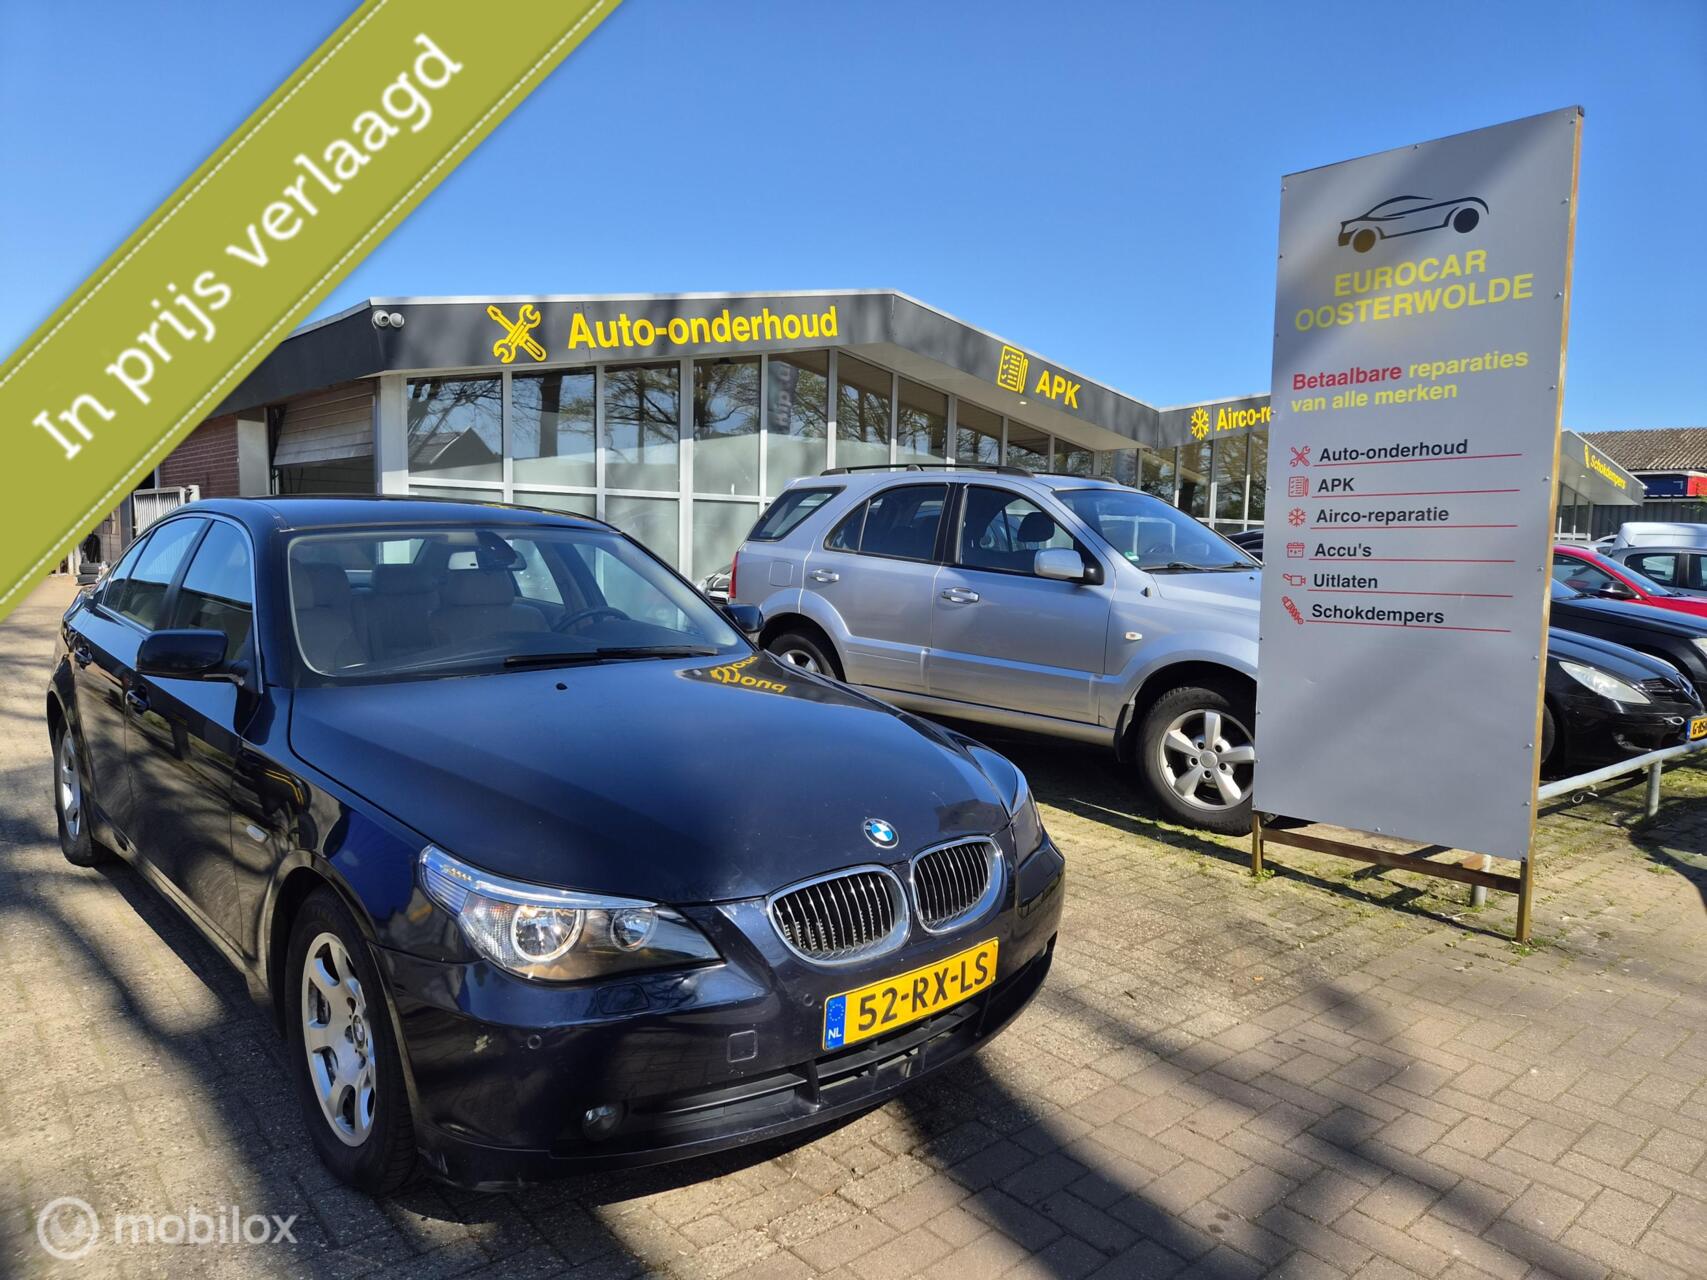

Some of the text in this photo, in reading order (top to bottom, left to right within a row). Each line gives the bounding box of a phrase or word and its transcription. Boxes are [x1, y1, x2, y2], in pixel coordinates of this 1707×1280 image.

[1334, 250, 1488, 297] EUROCAR
[1295, 274, 1534, 332] OOSTERWOLDE
[567, 306, 839, 350] Auto-onderhoud
[1292, 351, 1529, 391] Betaalbare reparaties
[1034, 370, 1081, 409] APK
[1291, 384, 1458, 412] van alle merken
[1319, 439, 1469, 462] Auto-onderhoud
[1317, 477, 1355, 493] APK
[1316, 507, 1449, 525] Airco-reparatie
[1314, 543, 1372, 557] Accu's
[1313, 573, 1378, 589] Uitlaten
[1311, 604, 1445, 626] Schokdempers
[858, 951, 989, 1032] 52-RX-LS
[828, 1029, 842, 1039] NL
